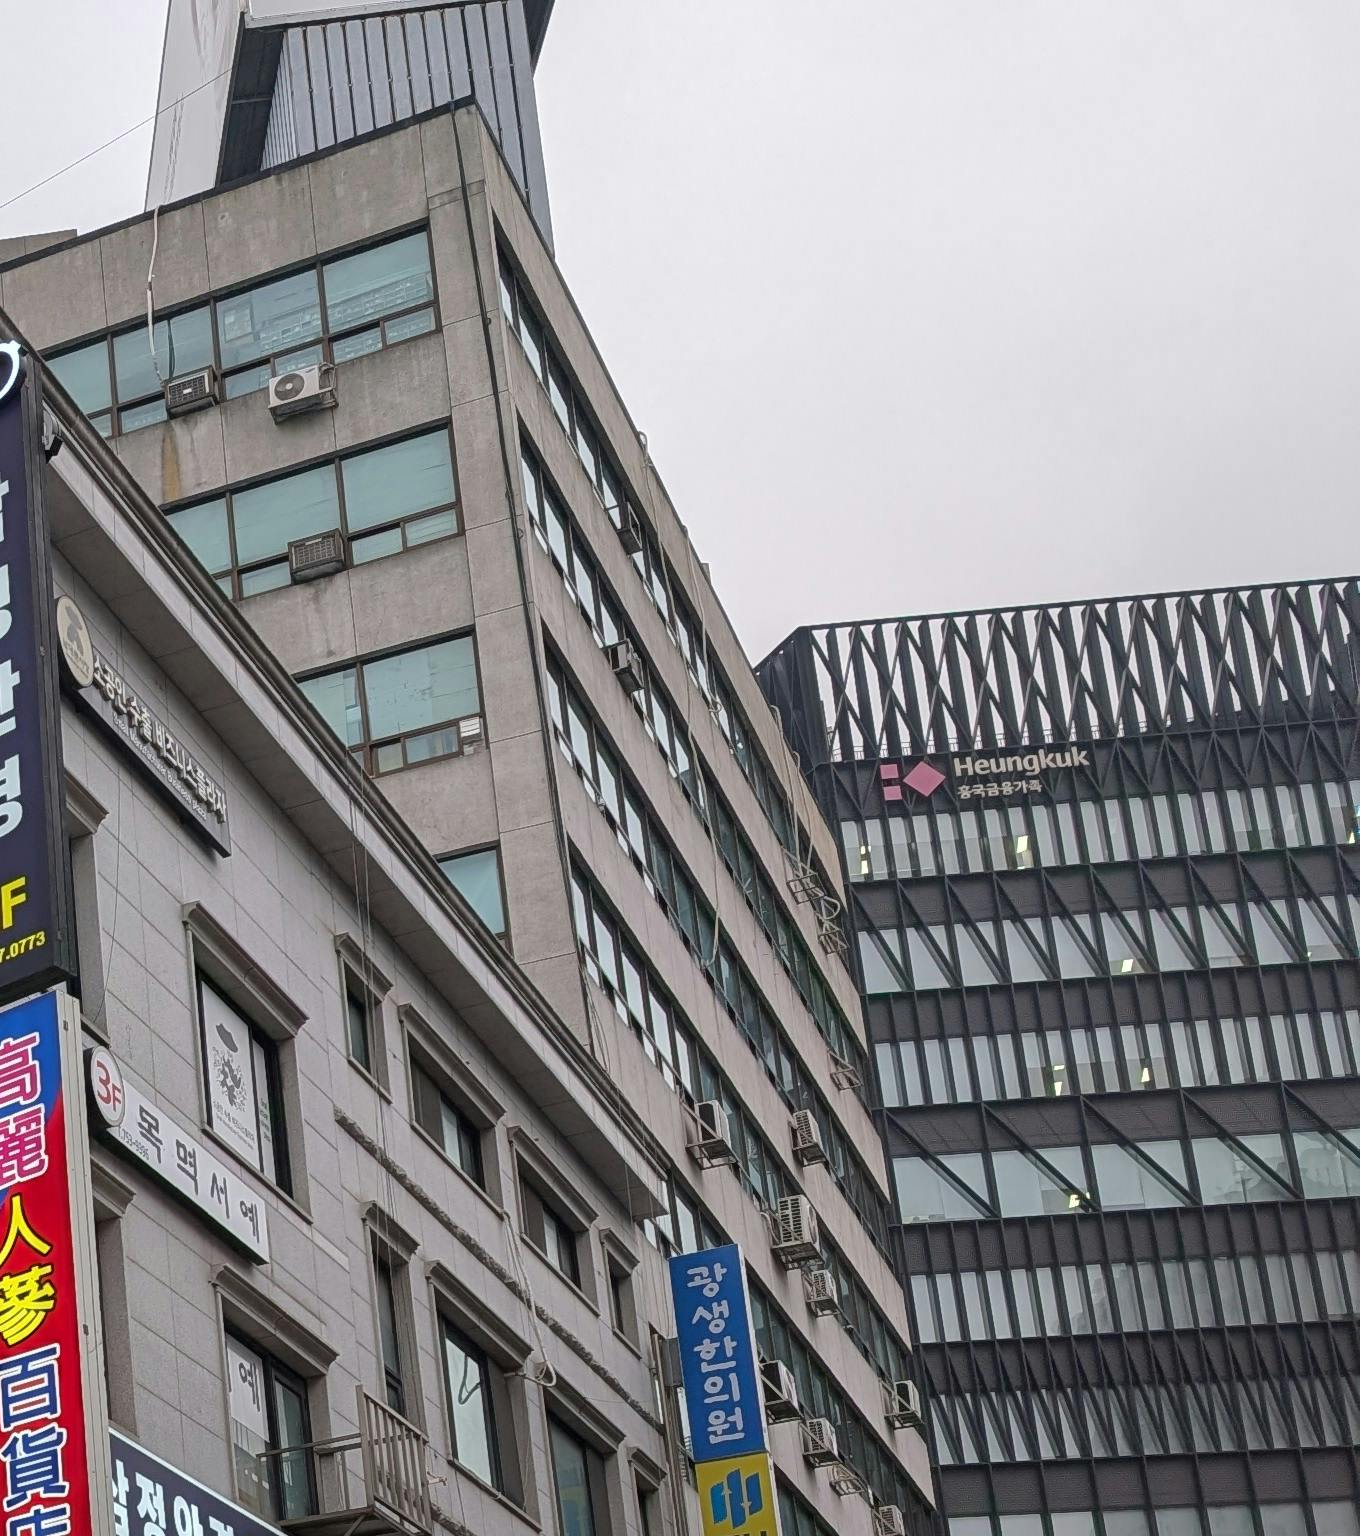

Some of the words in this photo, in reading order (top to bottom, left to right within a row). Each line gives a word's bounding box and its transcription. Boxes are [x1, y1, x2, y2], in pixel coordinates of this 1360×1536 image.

[953, 746, 1090, 777] Heungkuk
[95, 1059, 122, 1113] 3F
[685, 1262, 746, 1445] 광생한의원
